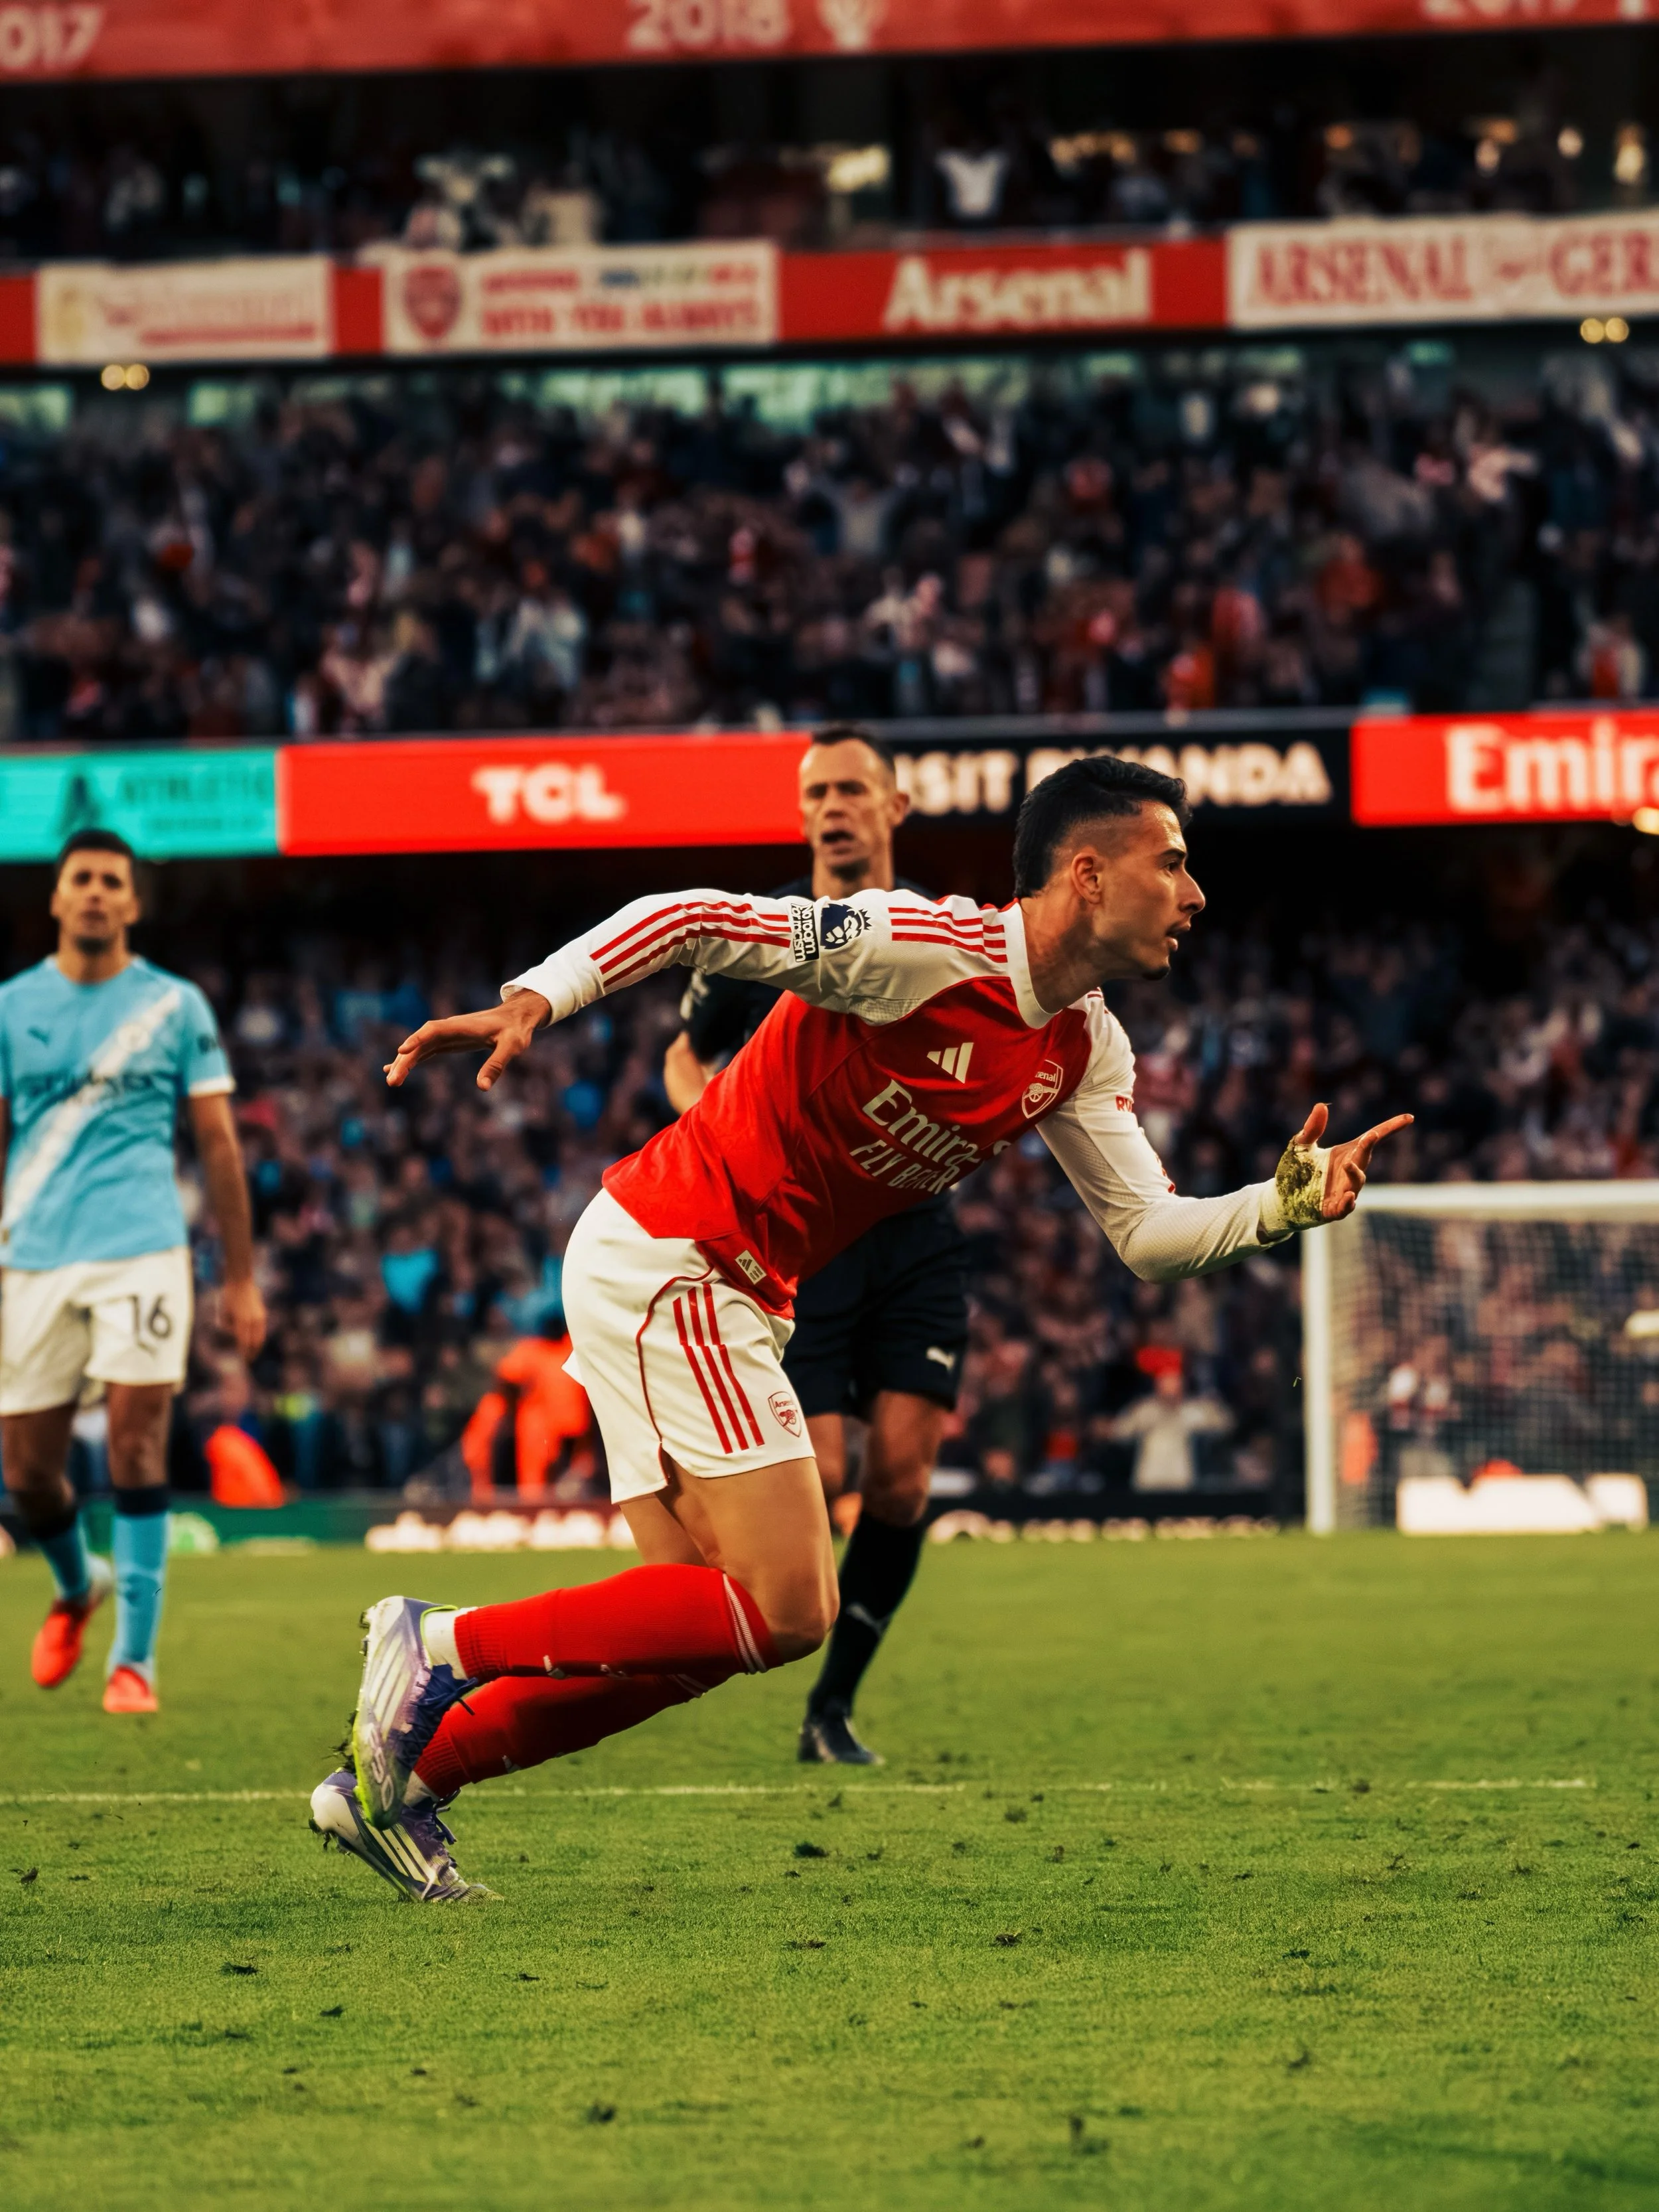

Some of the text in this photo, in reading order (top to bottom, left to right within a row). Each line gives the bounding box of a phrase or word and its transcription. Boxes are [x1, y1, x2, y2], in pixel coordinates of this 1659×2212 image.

[883, 255, 1152, 332] Arsenal
[470, 763, 628, 823] TCL
[895, 741, 1331, 816] ISIT RNDA
[1445, 718, 1659, 814] Emir
[1035, 1071, 1056, 1082] enal
[862, 1078, 1011, 1167] Emira
[849, 1140, 908, 1177] FLY
[126, 1293, 174, 1357] 16
